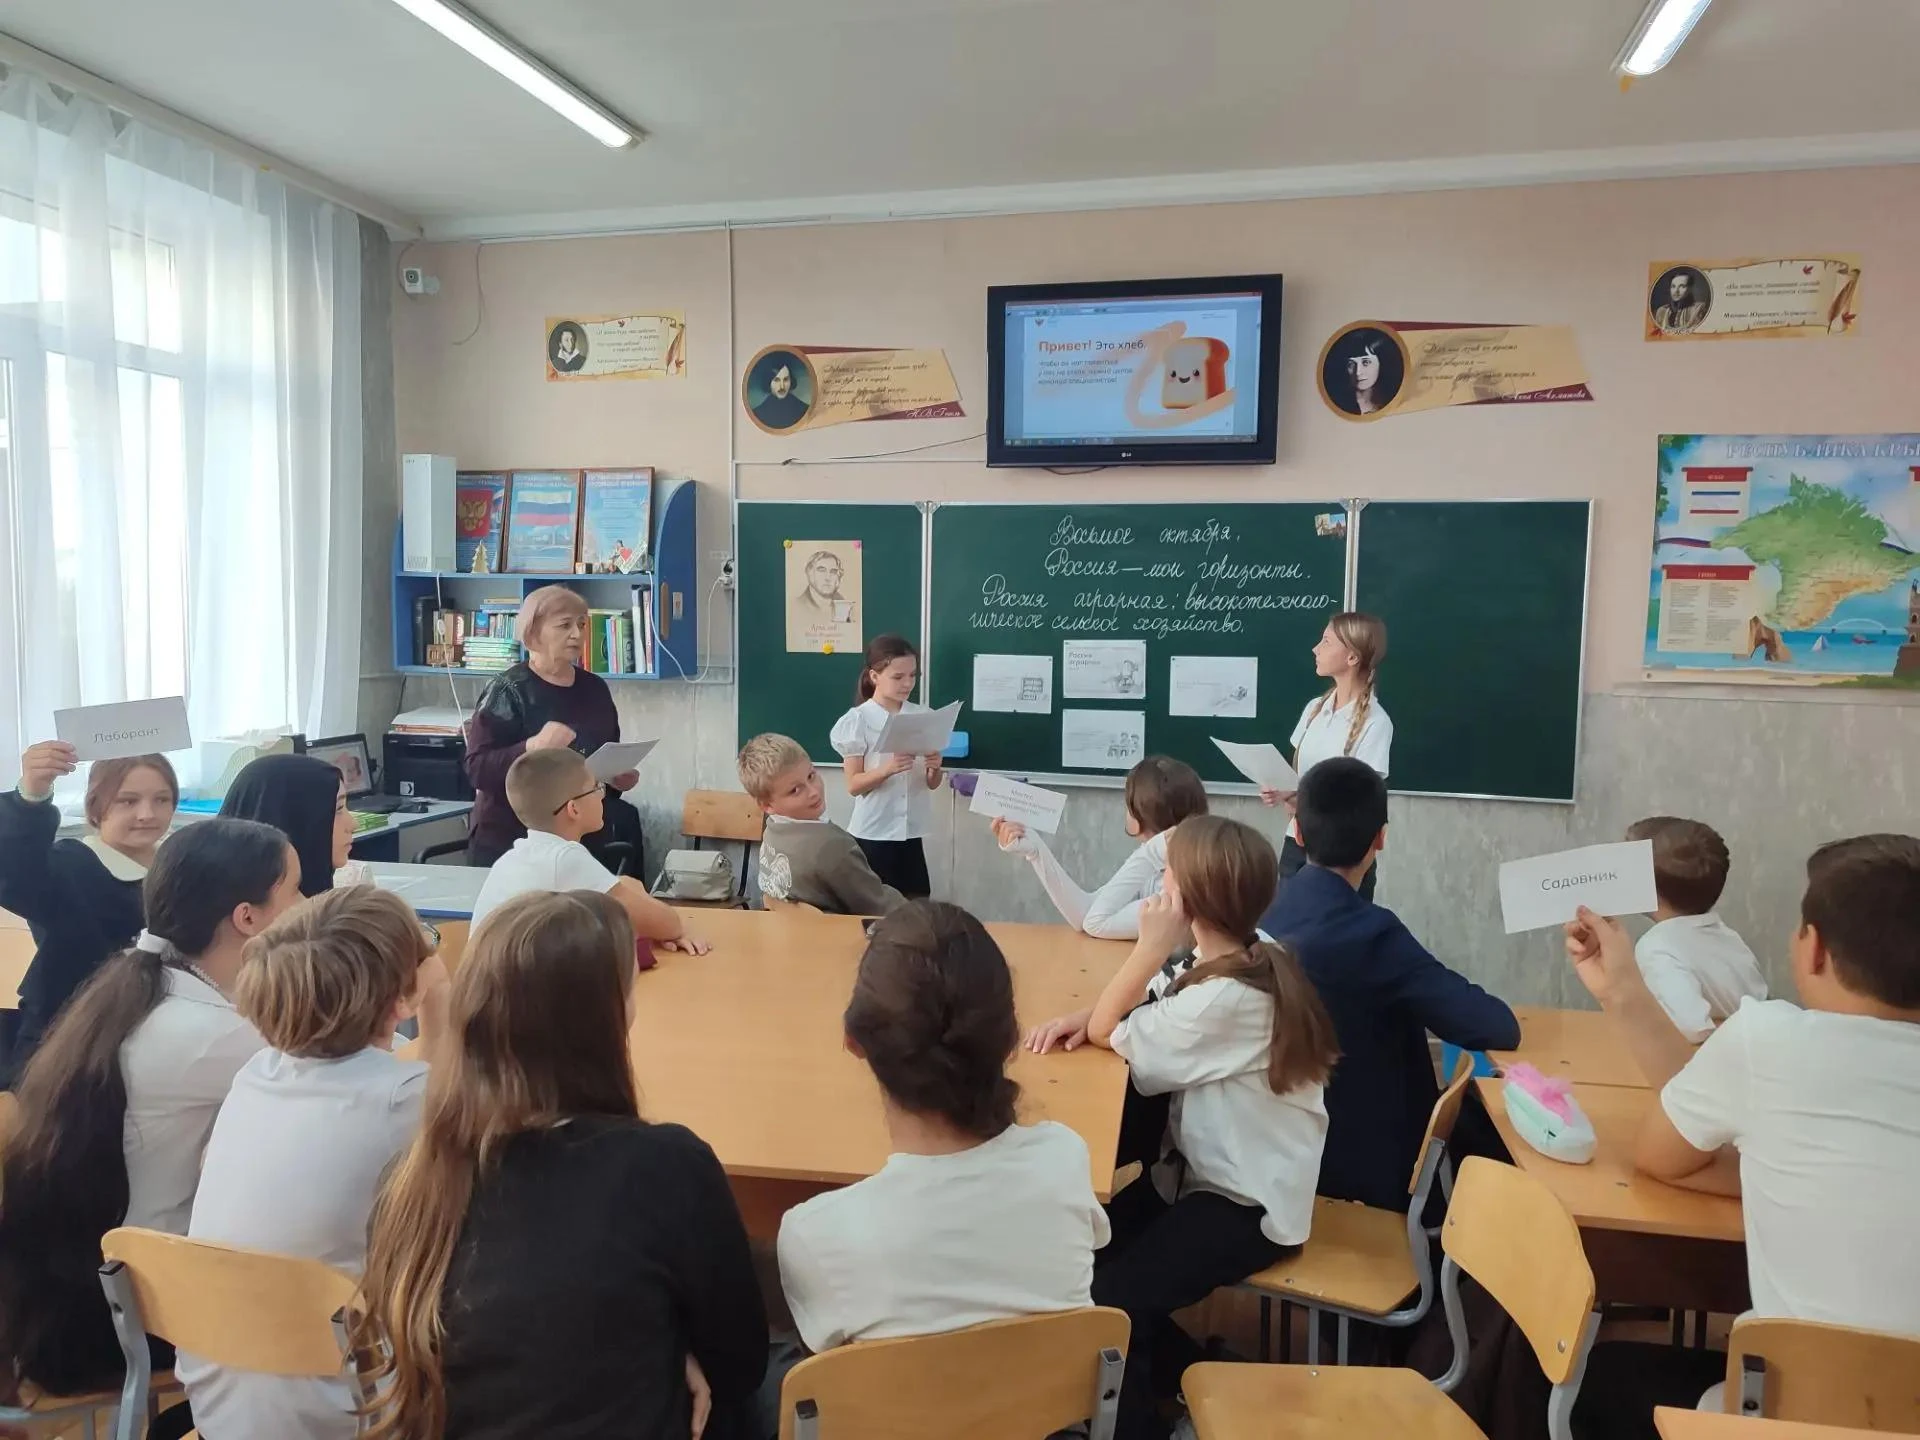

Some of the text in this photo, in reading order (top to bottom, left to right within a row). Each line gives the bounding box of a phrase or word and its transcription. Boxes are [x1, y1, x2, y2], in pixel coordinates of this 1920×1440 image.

[1039, 340, 1092, 354] Привет!
[1095, 341, 1115, 350] Это
[1050, 515, 1135, 546] Восьмое
[1044, 547, 1120, 576] Россия
[1143, 562, 1185, 577] мои
[93, 728, 160, 743] Лаборант
[1541, 871, 1618, 891] Садовник
